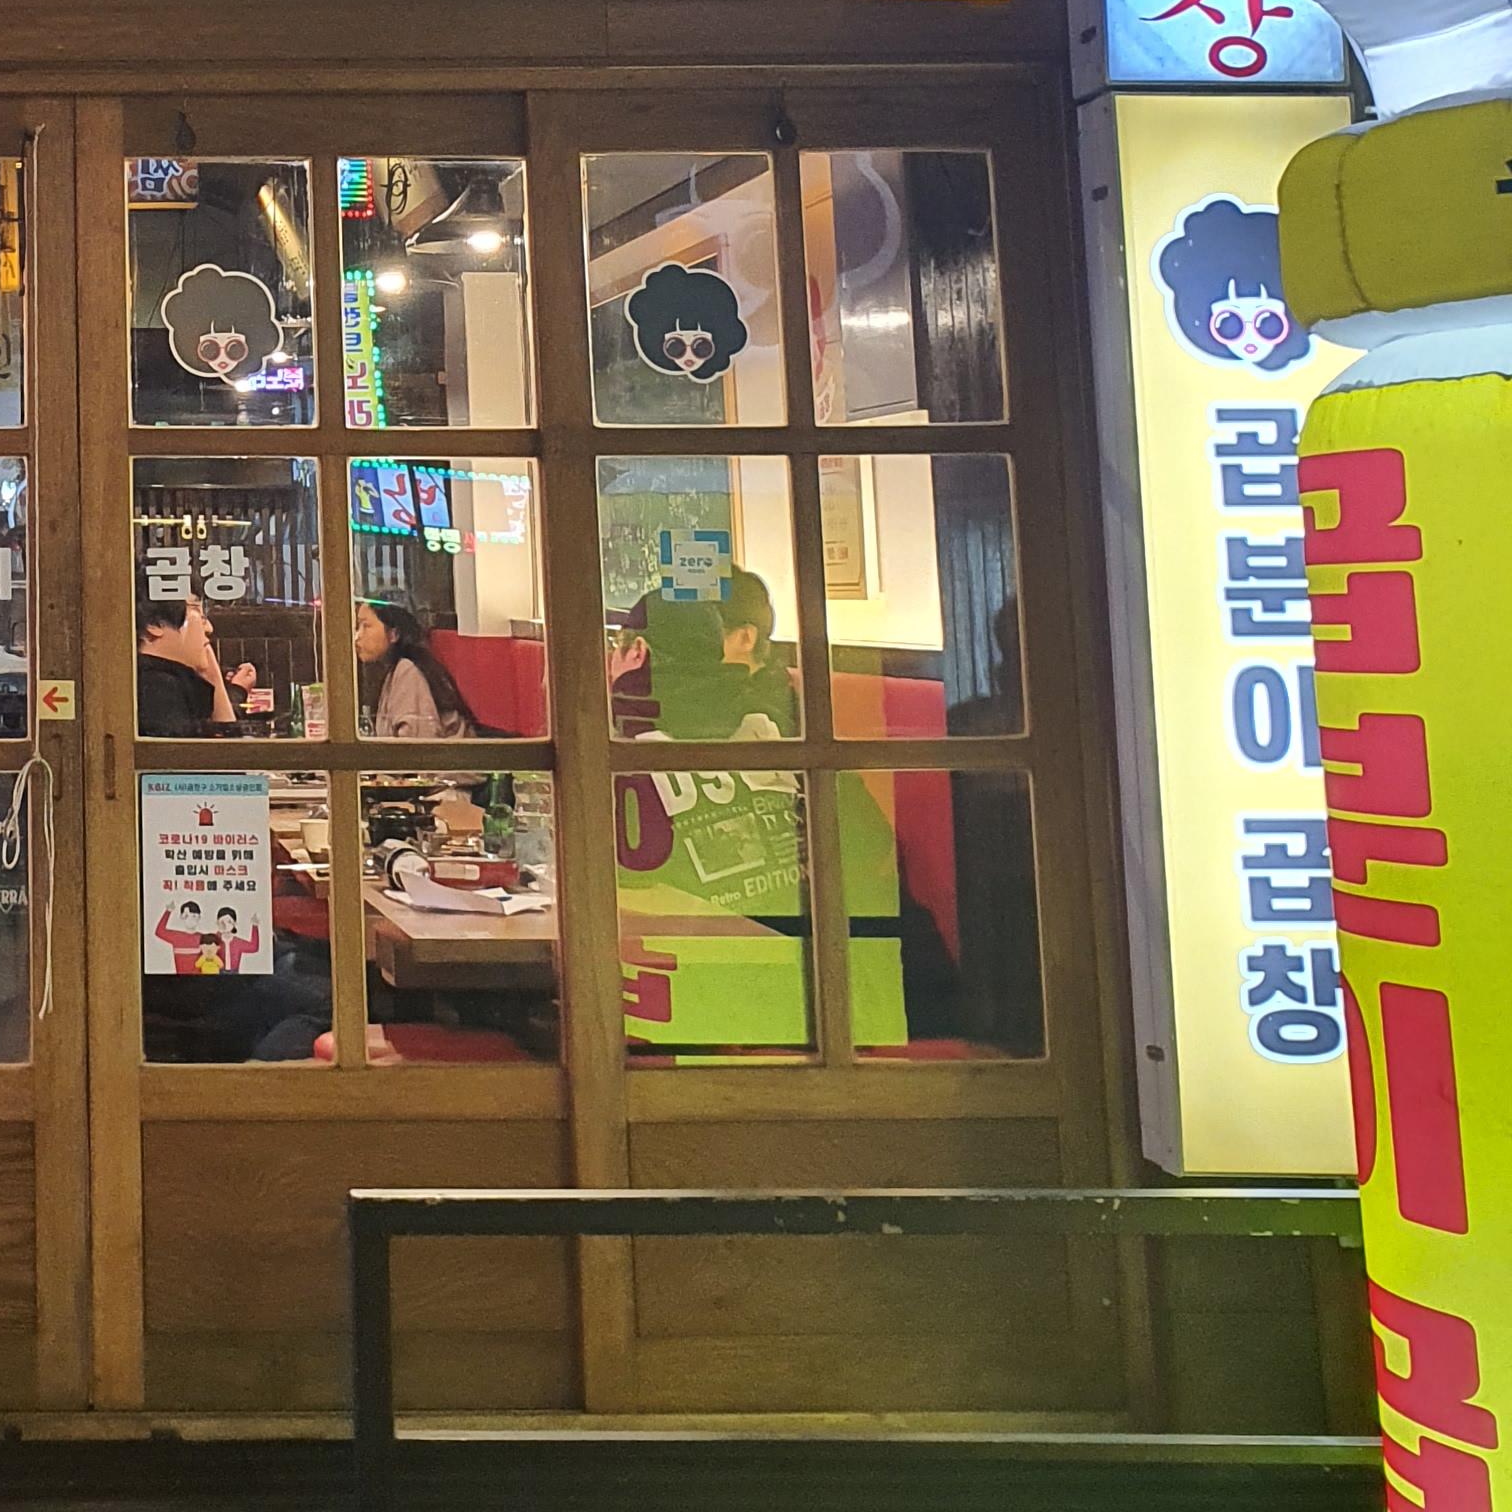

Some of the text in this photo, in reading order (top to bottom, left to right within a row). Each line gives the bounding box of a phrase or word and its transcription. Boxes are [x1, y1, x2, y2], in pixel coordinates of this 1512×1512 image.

[144, 544, 250, 601] 곱창
[158, 833, 260, 845] 코로나19 바이러스
[214, 864, 249, 876] 마스크
[223, 879, 257, 892] 주세요
